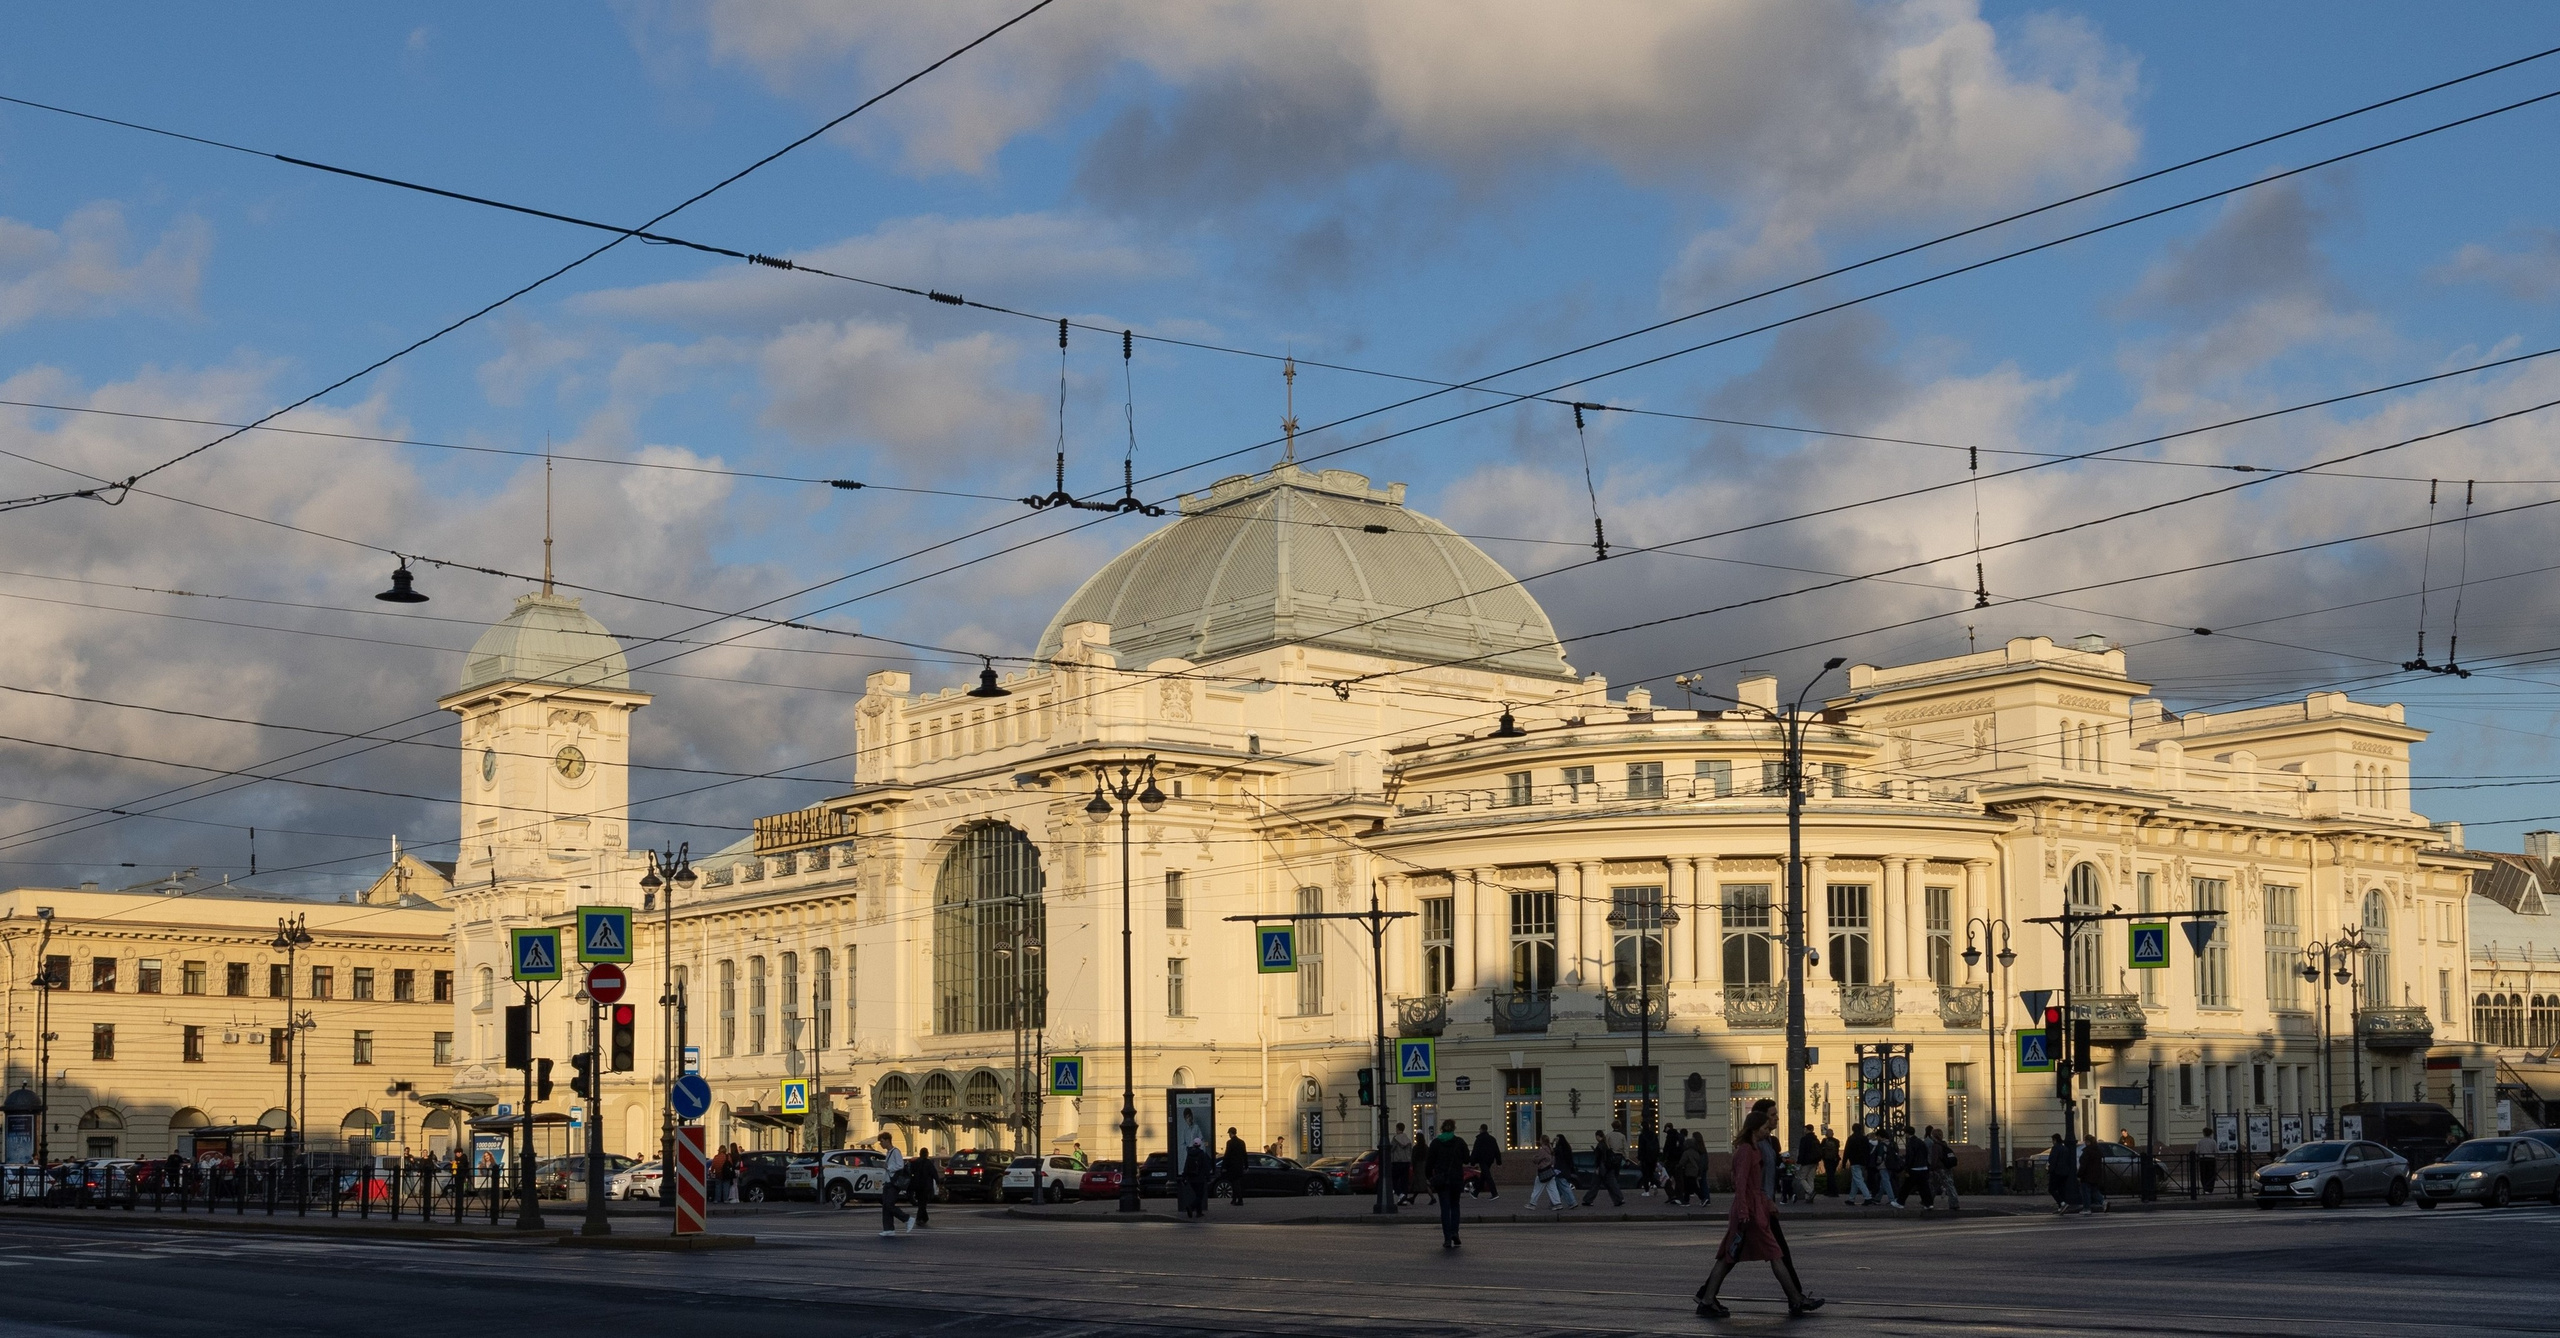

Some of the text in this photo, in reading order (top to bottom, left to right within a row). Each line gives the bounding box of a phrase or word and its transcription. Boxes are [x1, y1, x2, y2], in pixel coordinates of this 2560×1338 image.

[1616, 1084, 1657, 1092] SUBWY
[1732, 1082, 1771, 1090] SUBWAY
[1311, 1114, 1321, 1147] cofix
[854, 1174, 873, 1192] Go
